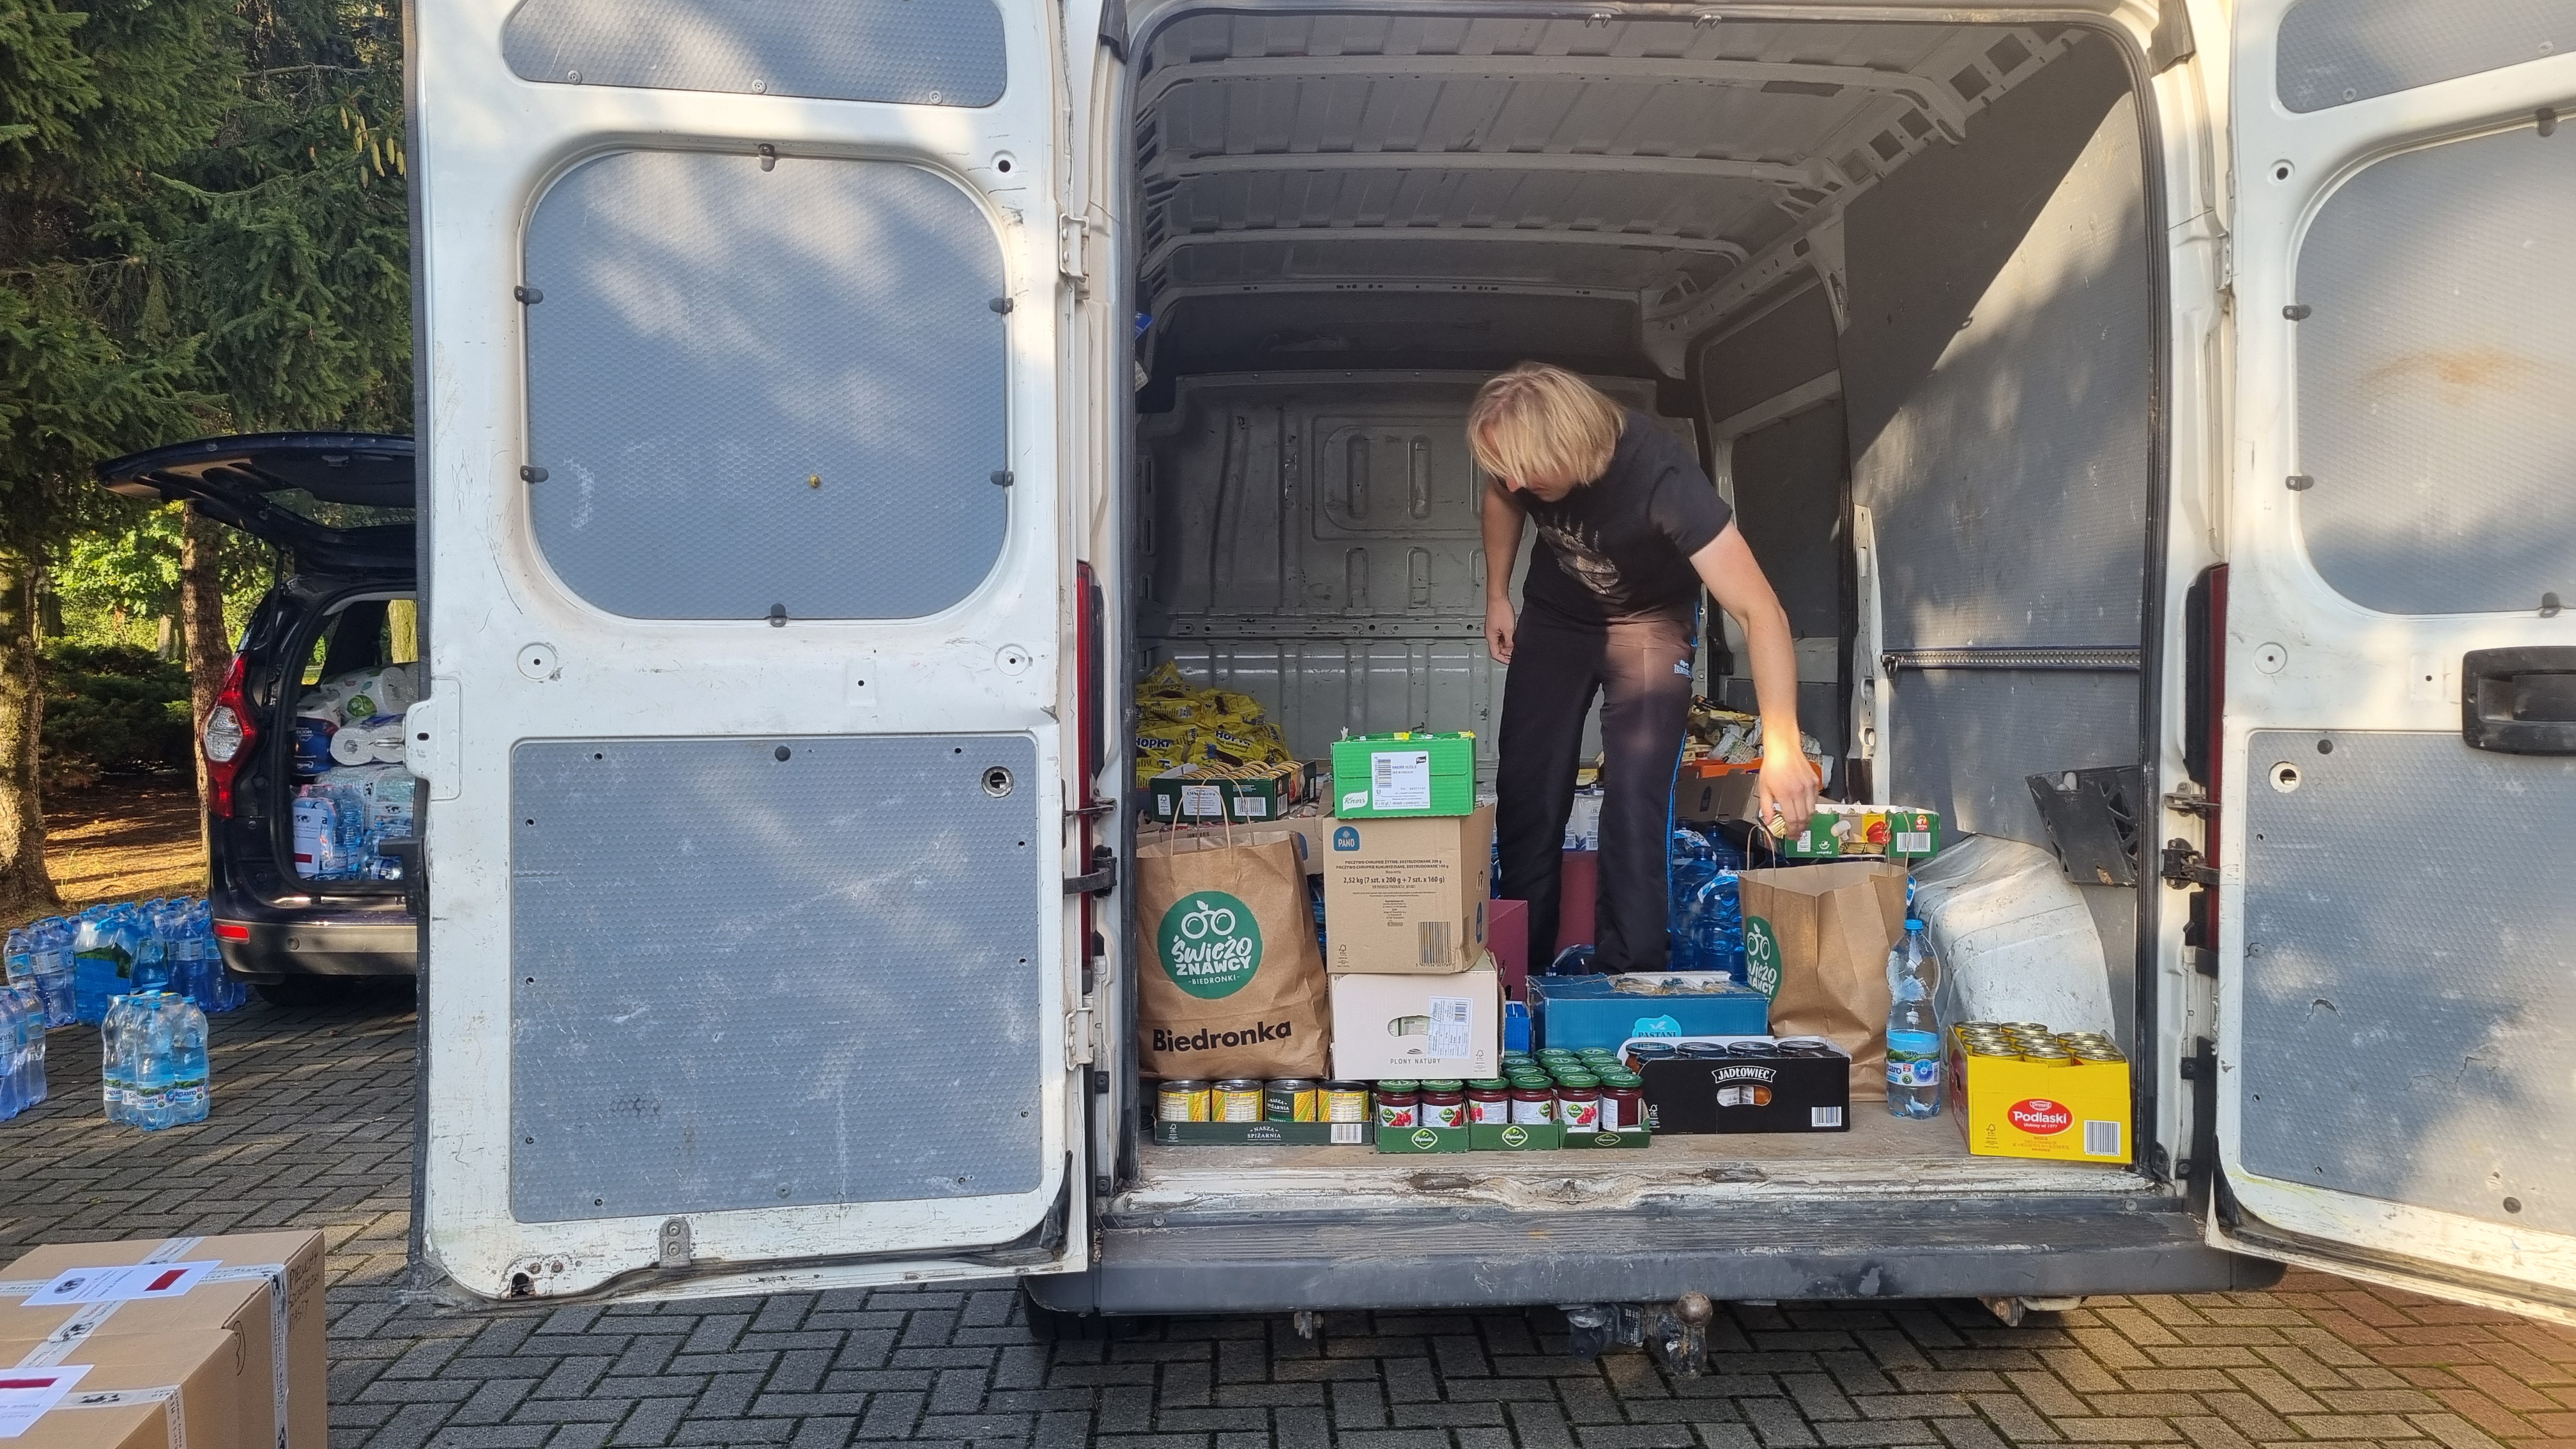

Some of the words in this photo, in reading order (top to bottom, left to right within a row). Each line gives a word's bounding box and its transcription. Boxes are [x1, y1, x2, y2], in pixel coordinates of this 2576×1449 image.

[1338, 838, 1355, 848] PANO
[1356, 877, 1363, 885] kg
[1176, 956, 1252, 976] ZNAWCY
[1153, 1021, 1292, 1052] Biedronka
[1719, 1067, 1769, 1080] JADŁOWIEC
[2013, 1110, 2067, 1124] Podlaski
